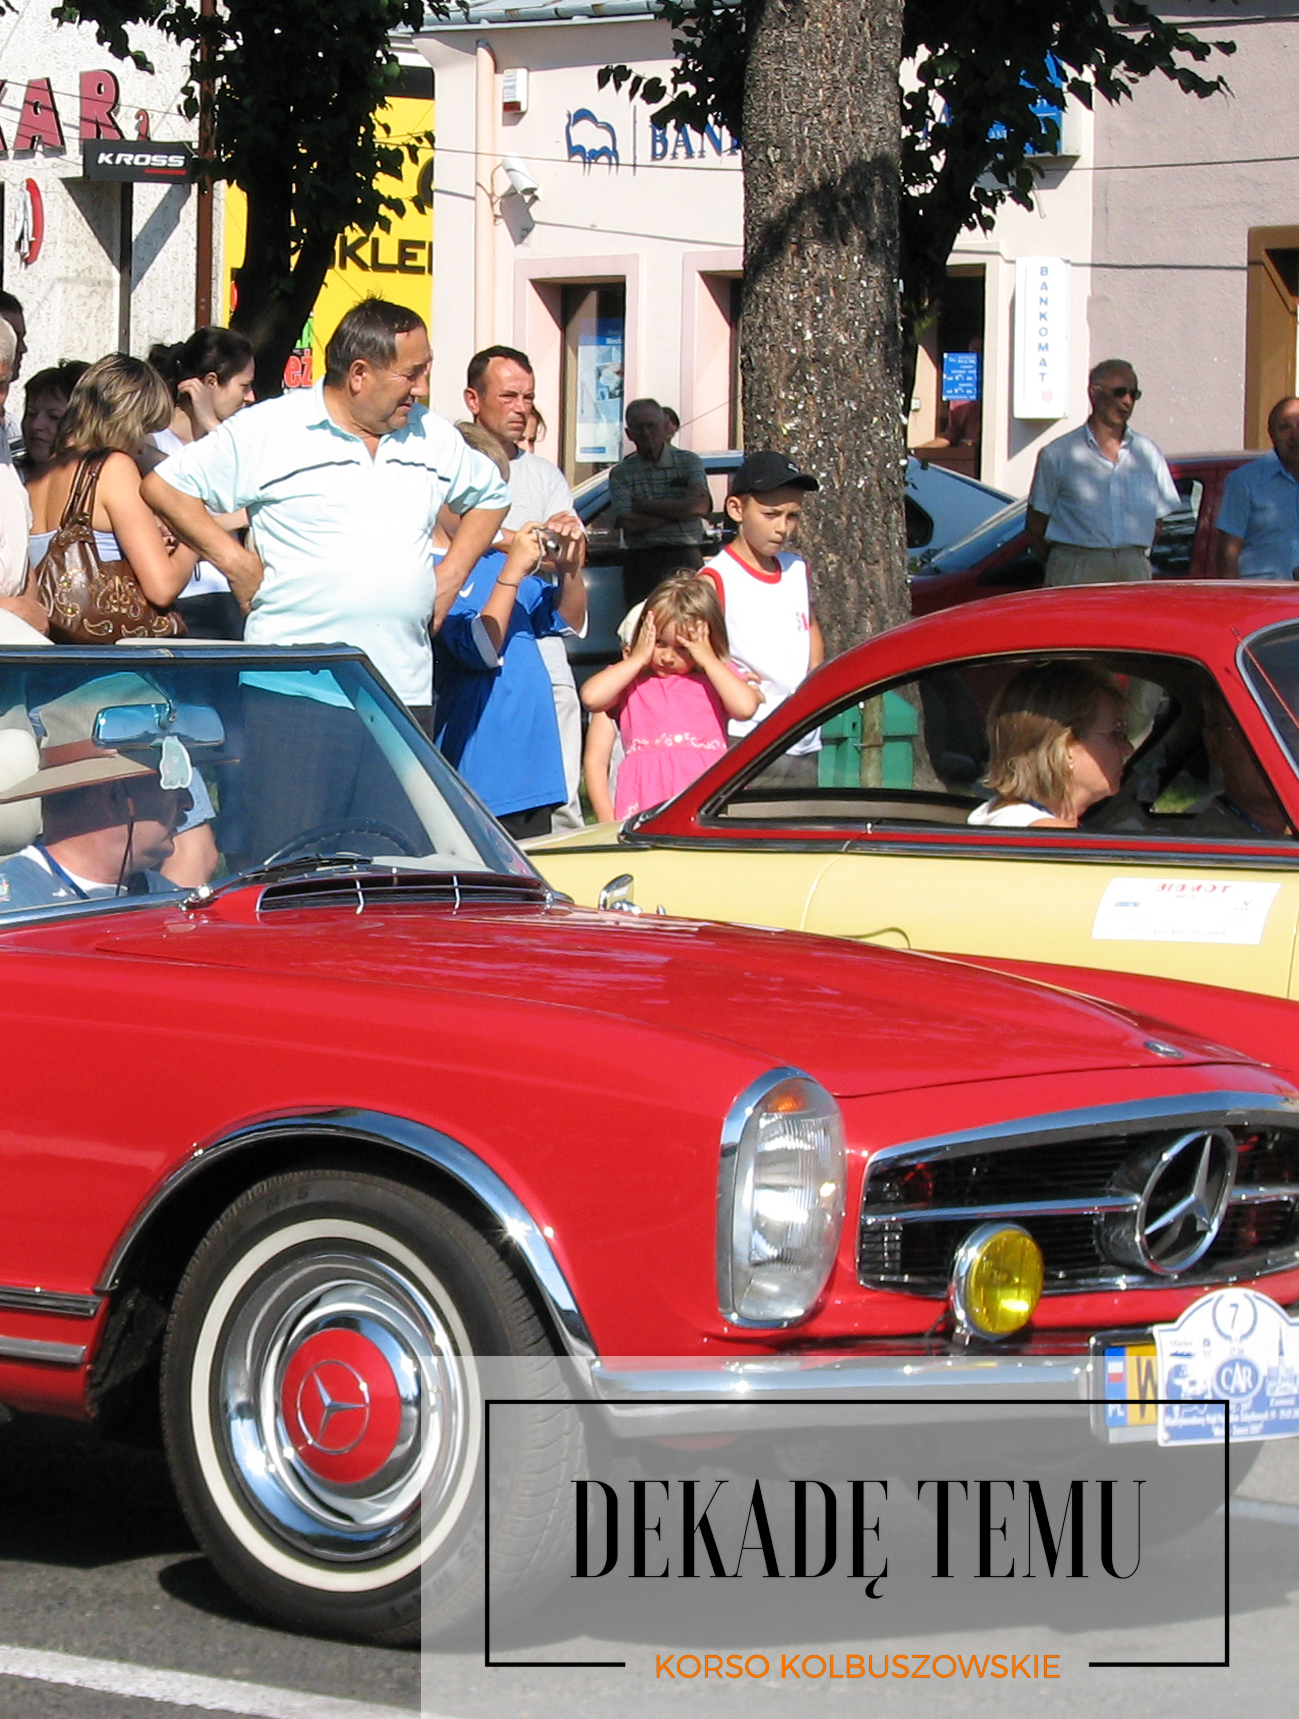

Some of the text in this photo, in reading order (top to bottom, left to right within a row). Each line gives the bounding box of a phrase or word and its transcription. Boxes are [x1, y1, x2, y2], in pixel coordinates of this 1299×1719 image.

[650, 116, 740, 162] BAN
[98, 152, 185, 167] KROSS
[1037, 266, 1049, 382] BANKOMAT
[1229, 1303, 1240, 1330] 7
[1220, 1362, 1253, 1394] CAR
